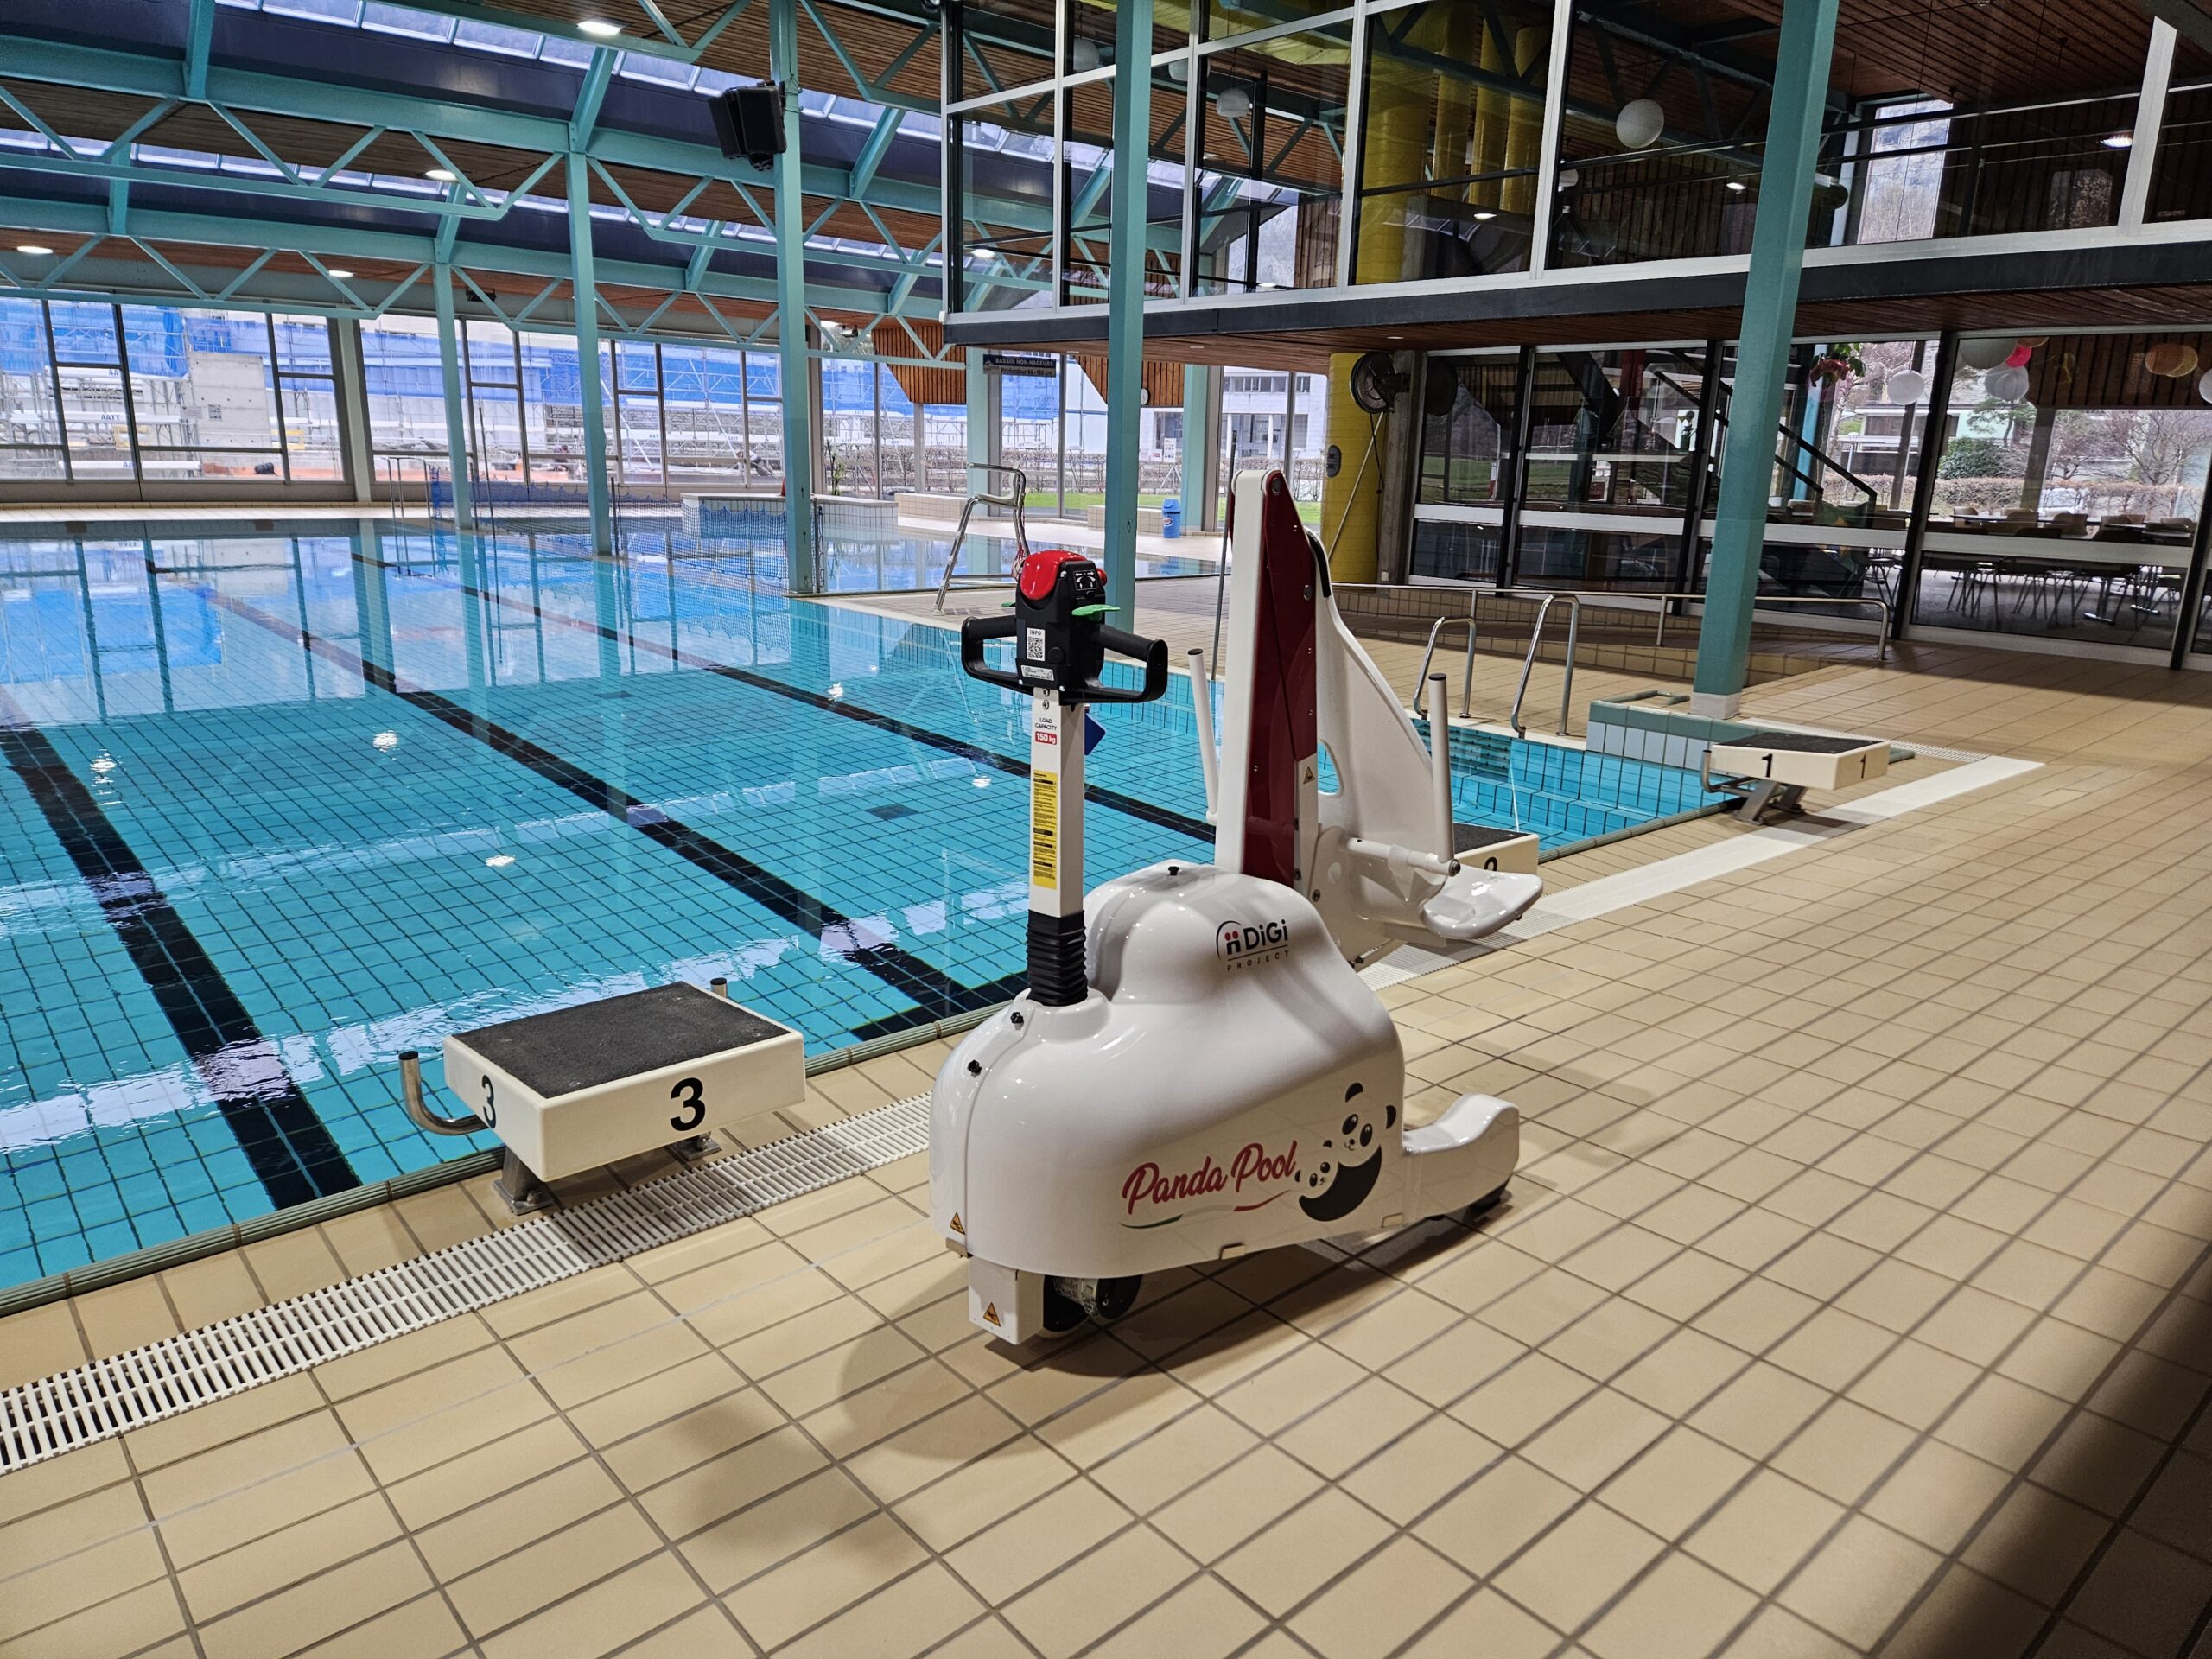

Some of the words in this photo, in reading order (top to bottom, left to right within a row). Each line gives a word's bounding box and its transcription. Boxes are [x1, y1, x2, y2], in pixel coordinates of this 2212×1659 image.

[1036, 732, 1048, 742] 150
[1049, 734, 1056, 745] kg
[1762, 753, 1772, 778] 1
[1860, 753, 1866, 779] 1
[1227, 950, 1288, 972] PROJECT
[481, 1074, 497, 1130] 3
[670, 1077, 707, 1132] 3
[1122, 1155, 1229, 1215] Panda
[1230, 1140, 1298, 1193] Pool
